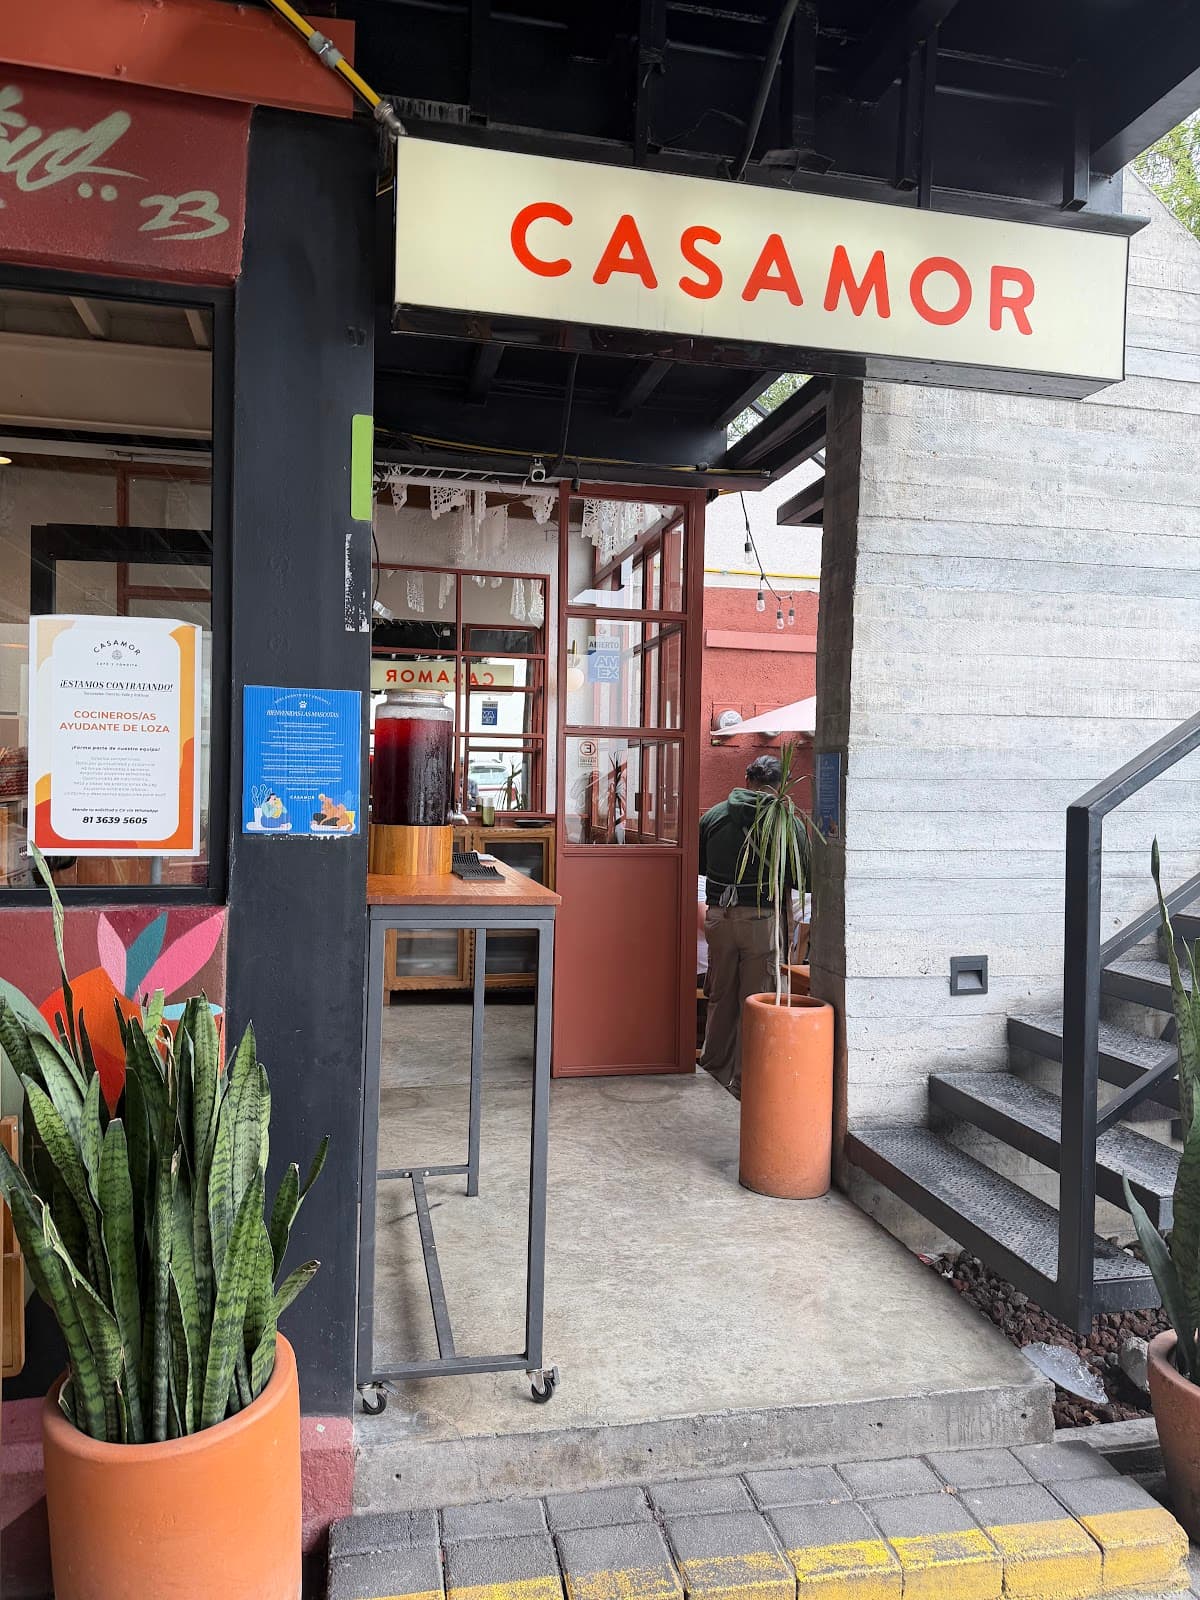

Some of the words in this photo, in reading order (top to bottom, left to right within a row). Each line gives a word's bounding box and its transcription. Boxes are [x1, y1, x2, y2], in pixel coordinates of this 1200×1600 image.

[138, 190, 230, 240] 23
[509, 201, 1036, 336] CASAMOR
[93, 639, 141, 656] CASAMOR
[589, 641, 619, 649] ABIERTO
[73, 710, 157, 721] COCINEROS/AS
[59, 722, 120, 732] AYUDANTE
[123, 723, 138, 732] DE
[141, 724, 170, 733] LOZA
[82, 816, 93, 824] 81
[95, 816, 120, 824] 3639
